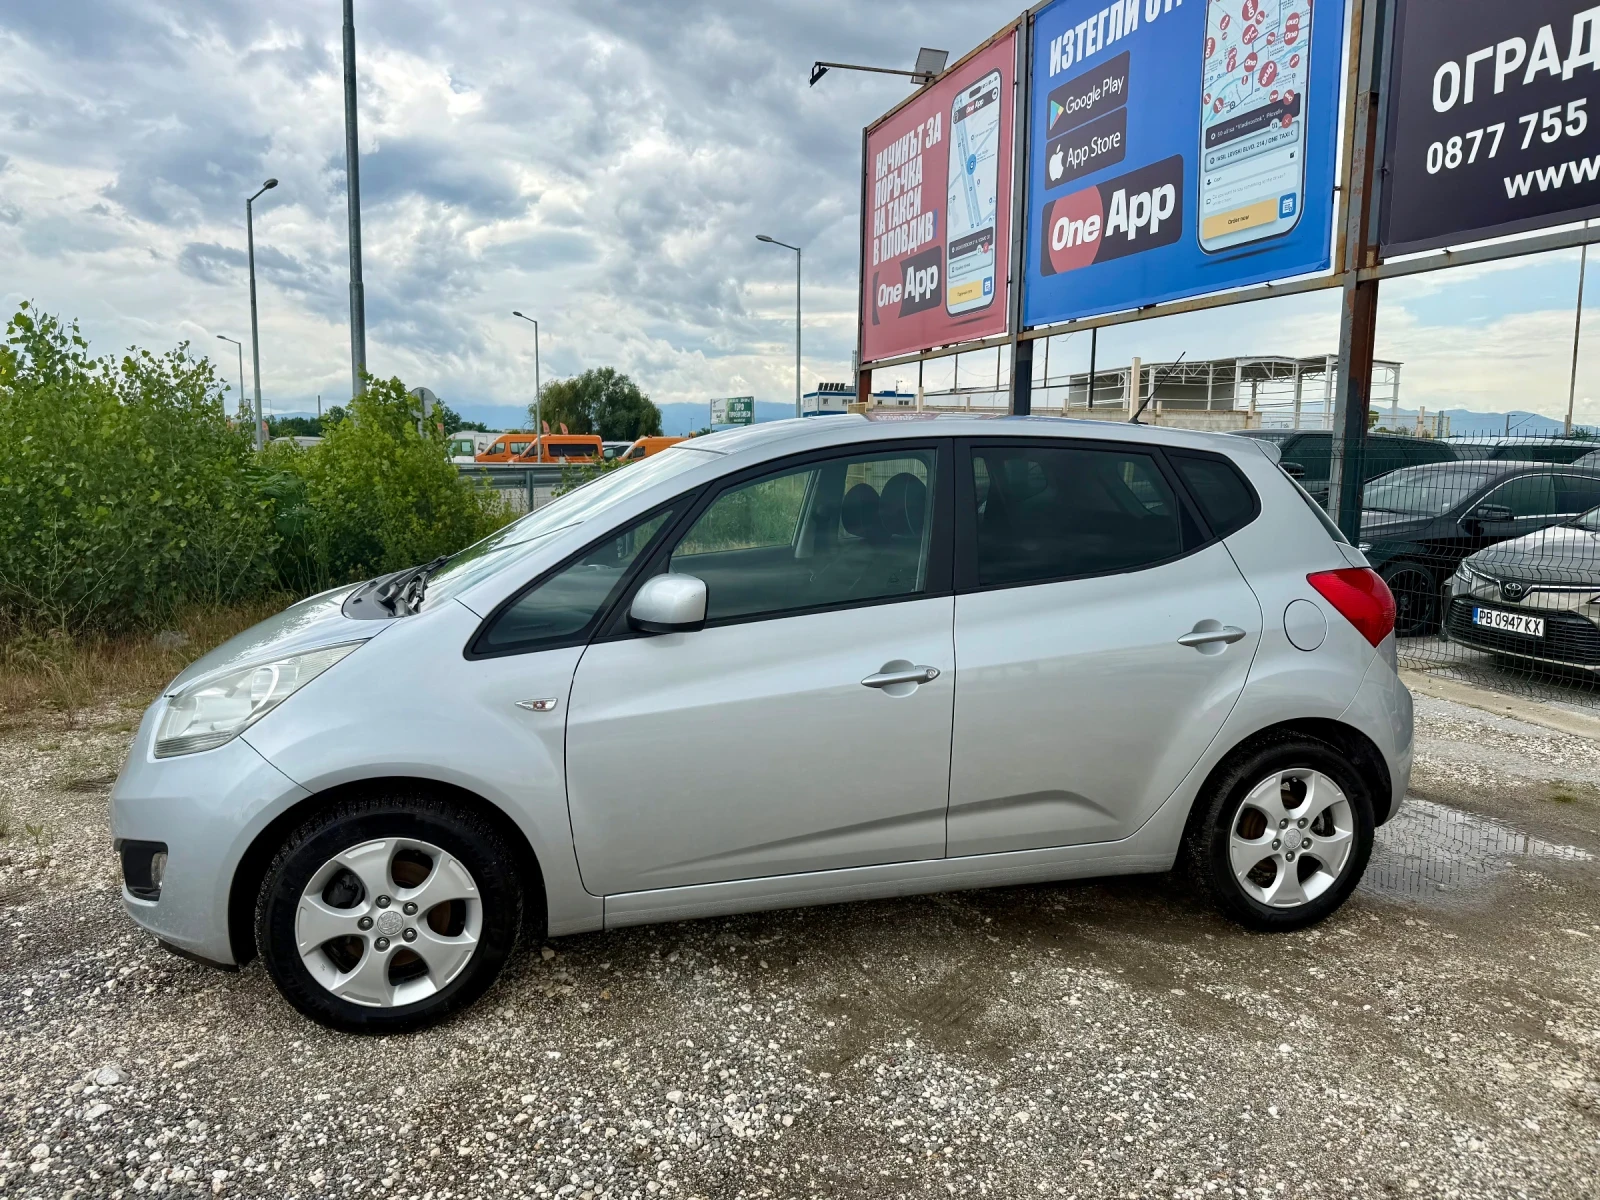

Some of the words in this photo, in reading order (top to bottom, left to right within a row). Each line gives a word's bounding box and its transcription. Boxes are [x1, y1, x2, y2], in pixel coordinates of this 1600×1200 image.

[1049, 0, 1140, 78] ИЗТЕГЛИ
[1066, 85, 1101, 114] Google
[1102, 75, 1125, 97] Play
[876, 123, 925, 182] НАЧИНЪТ
[925, 111, 942, 149] ЗА
[1066, 145, 1089, 169] App
[1090, 131, 1121, 157] Store
[1426, 122, 1505, 175] 0877
[1518, 98, 1588, 150] 755
[875, 154, 923, 210] ПОРЪЧКА
[872, 237, 880, 267] В
[880, 211, 934, 263] ПЛОВДИВ
[874, 205, 886, 239] НА
[887, 185, 922, 230] ТАКСИ
[1051, 213, 1101, 251] One
[1104, 183, 1176, 240] App
[877, 283, 903, 308] One
[904, 264, 939, 303] App
[1495, 614, 1523, 630] 0947
[1524, 618, 1541, 634] KX
